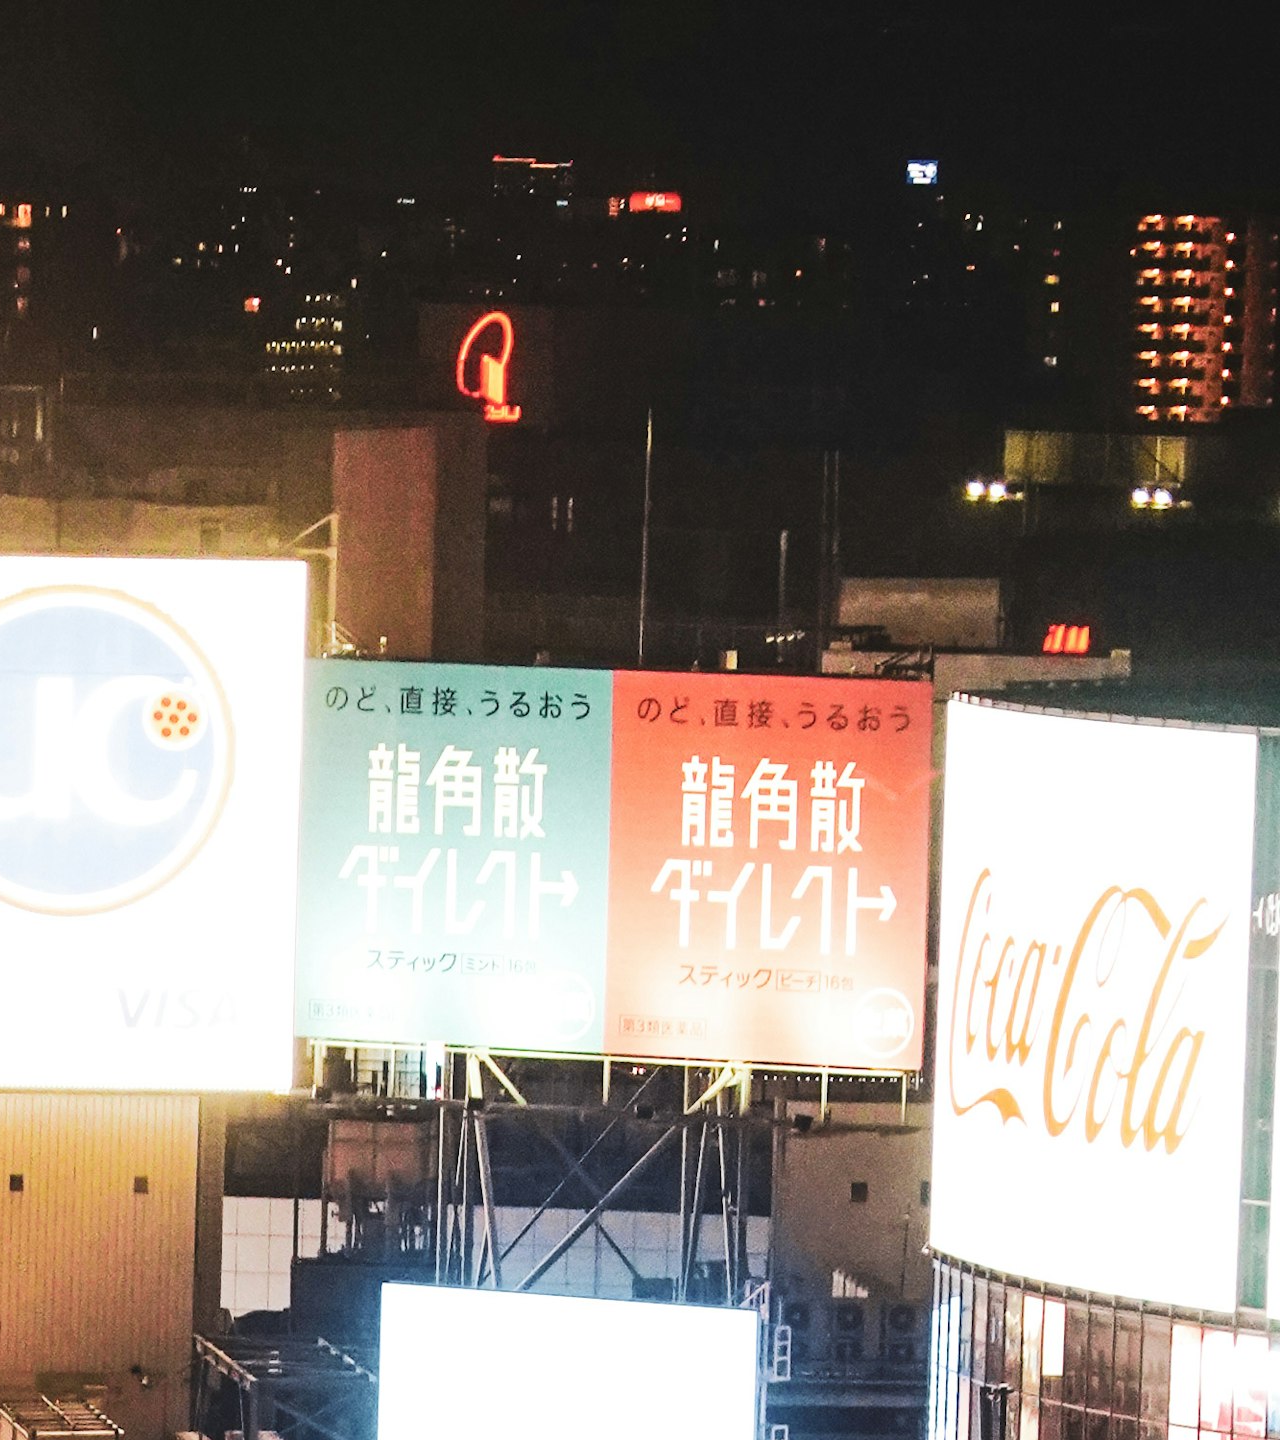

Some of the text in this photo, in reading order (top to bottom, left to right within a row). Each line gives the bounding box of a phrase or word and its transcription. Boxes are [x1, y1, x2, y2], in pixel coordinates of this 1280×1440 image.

[325, 685, 594, 722] のど、直接、うるおう
[635, 695, 914, 736] のど、直接、うるおう
[368, 742, 548, 840] 龍角散
[681, 755, 866, 854] 龍角散
[339, 845, 580, 942] ダイレクト
[651, 858, 898, 955] ダイレクト
[117, 988, 239, 1028] VISA
[679, 964, 772, 991] スティック
